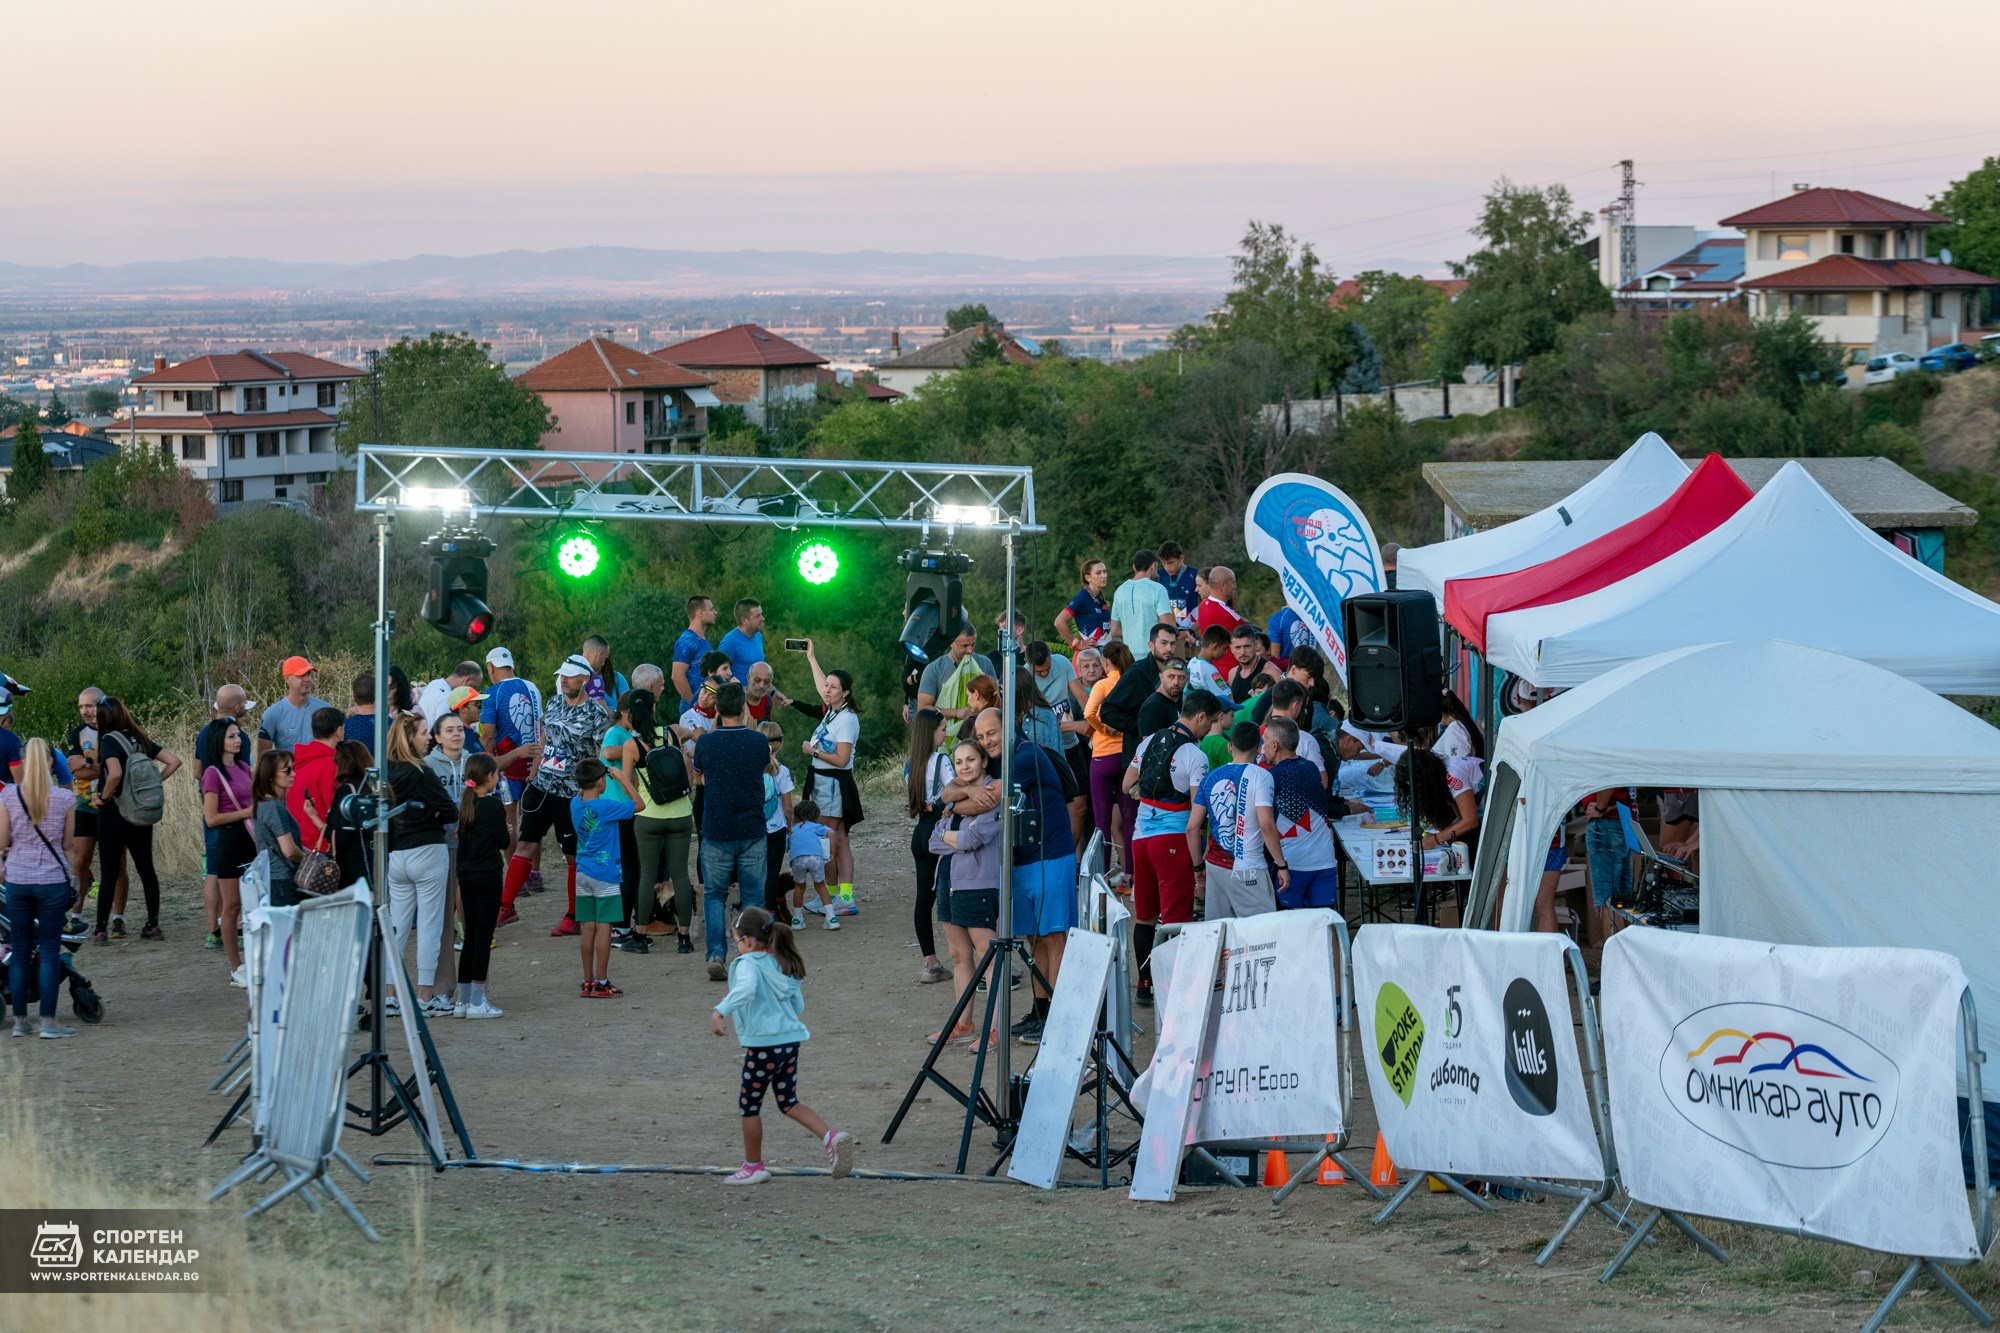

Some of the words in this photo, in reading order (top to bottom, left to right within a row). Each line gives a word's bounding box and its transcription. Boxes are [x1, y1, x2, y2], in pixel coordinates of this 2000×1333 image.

[1238, 777, 1249, 817] MATTERS
[1236, 815, 1245, 837] STEP
[1230, 868, 1257, 880] AIR
[1249, 941, 1277, 953] TRANSPORT
[1221, 956, 1277, 1014] ANT
[1392, 1005, 1417, 1050] POKE
[1392, 1030, 1424, 1094] STATION
[1512, 1028, 1547, 1076] hills
